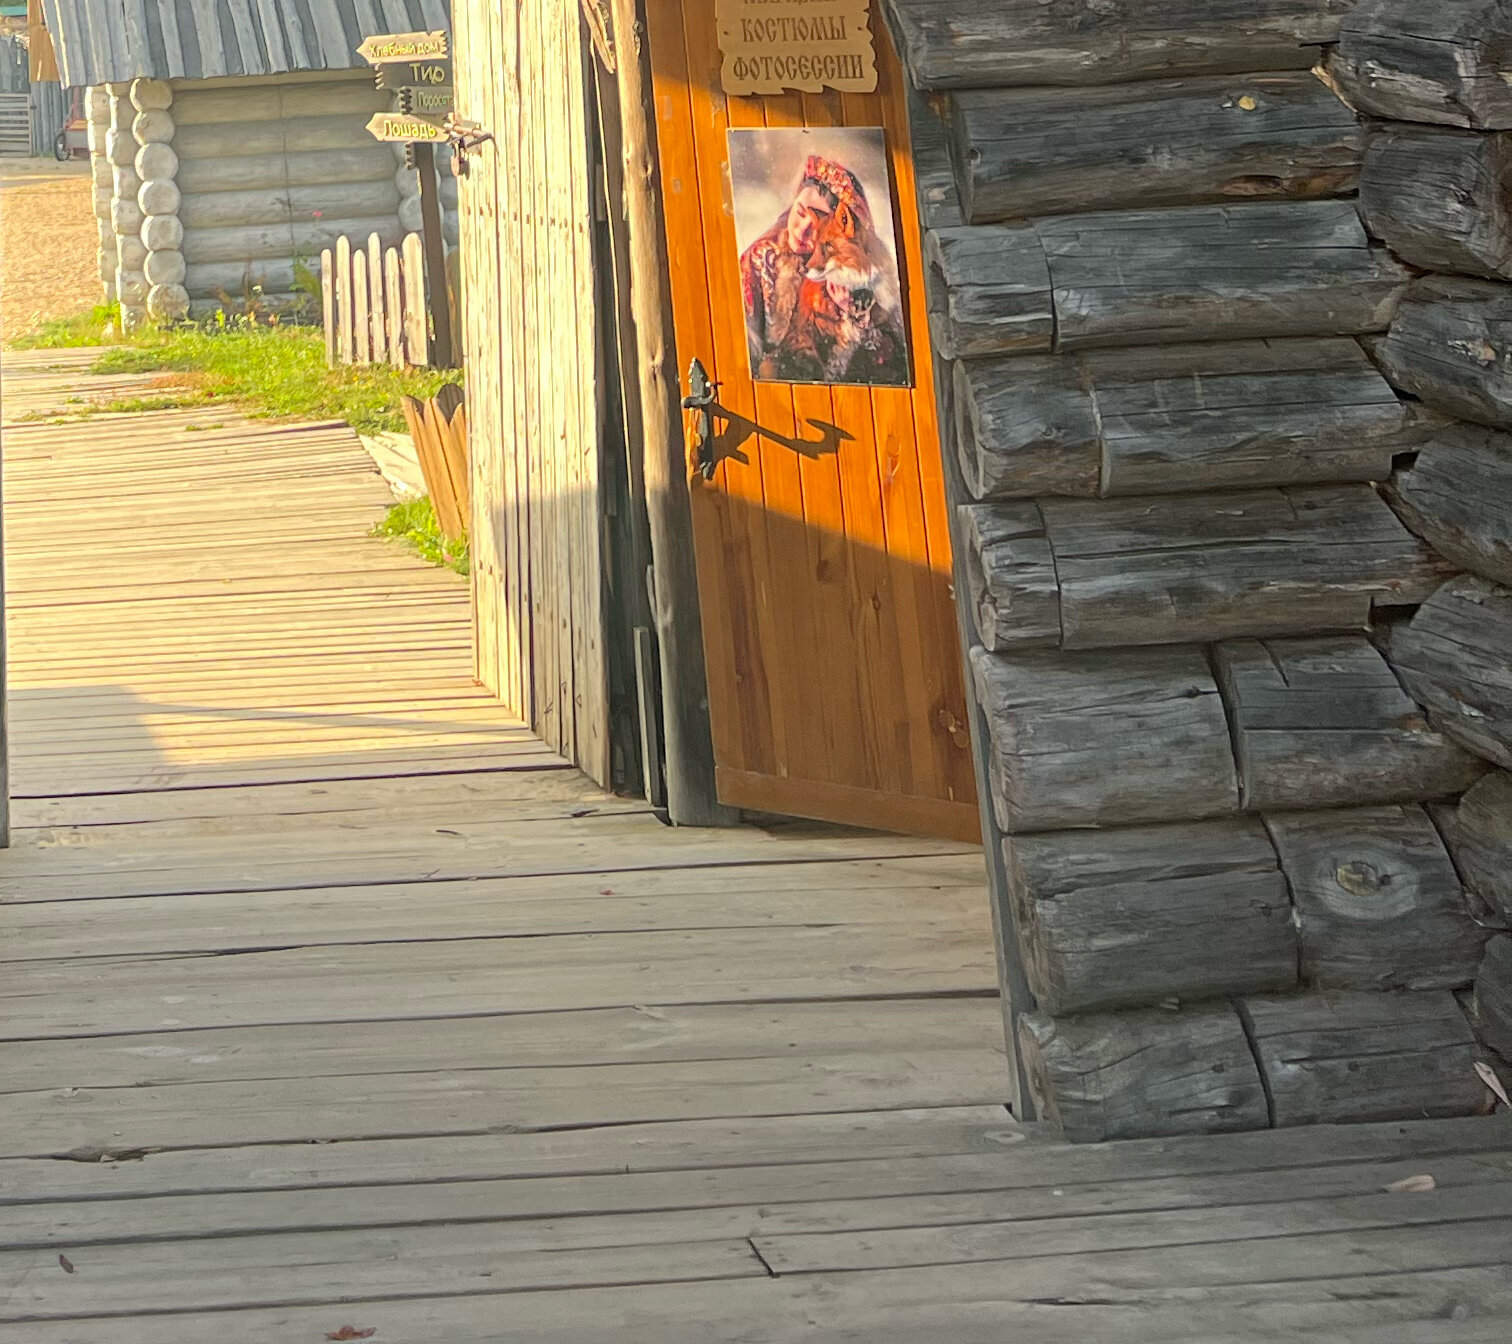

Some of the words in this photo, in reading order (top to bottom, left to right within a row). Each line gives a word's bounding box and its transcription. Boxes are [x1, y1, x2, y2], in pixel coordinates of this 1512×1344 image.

[740, 15, 848, 42] КОСТЮМЫ
[369, 41, 415, 57] Хлебный
[417, 42, 440, 55] дом
[409, 62, 445, 85] Тир
[733, 54, 864, 80] ФОТОСЕССИИ
[383, 119, 436, 139] Лошадь
